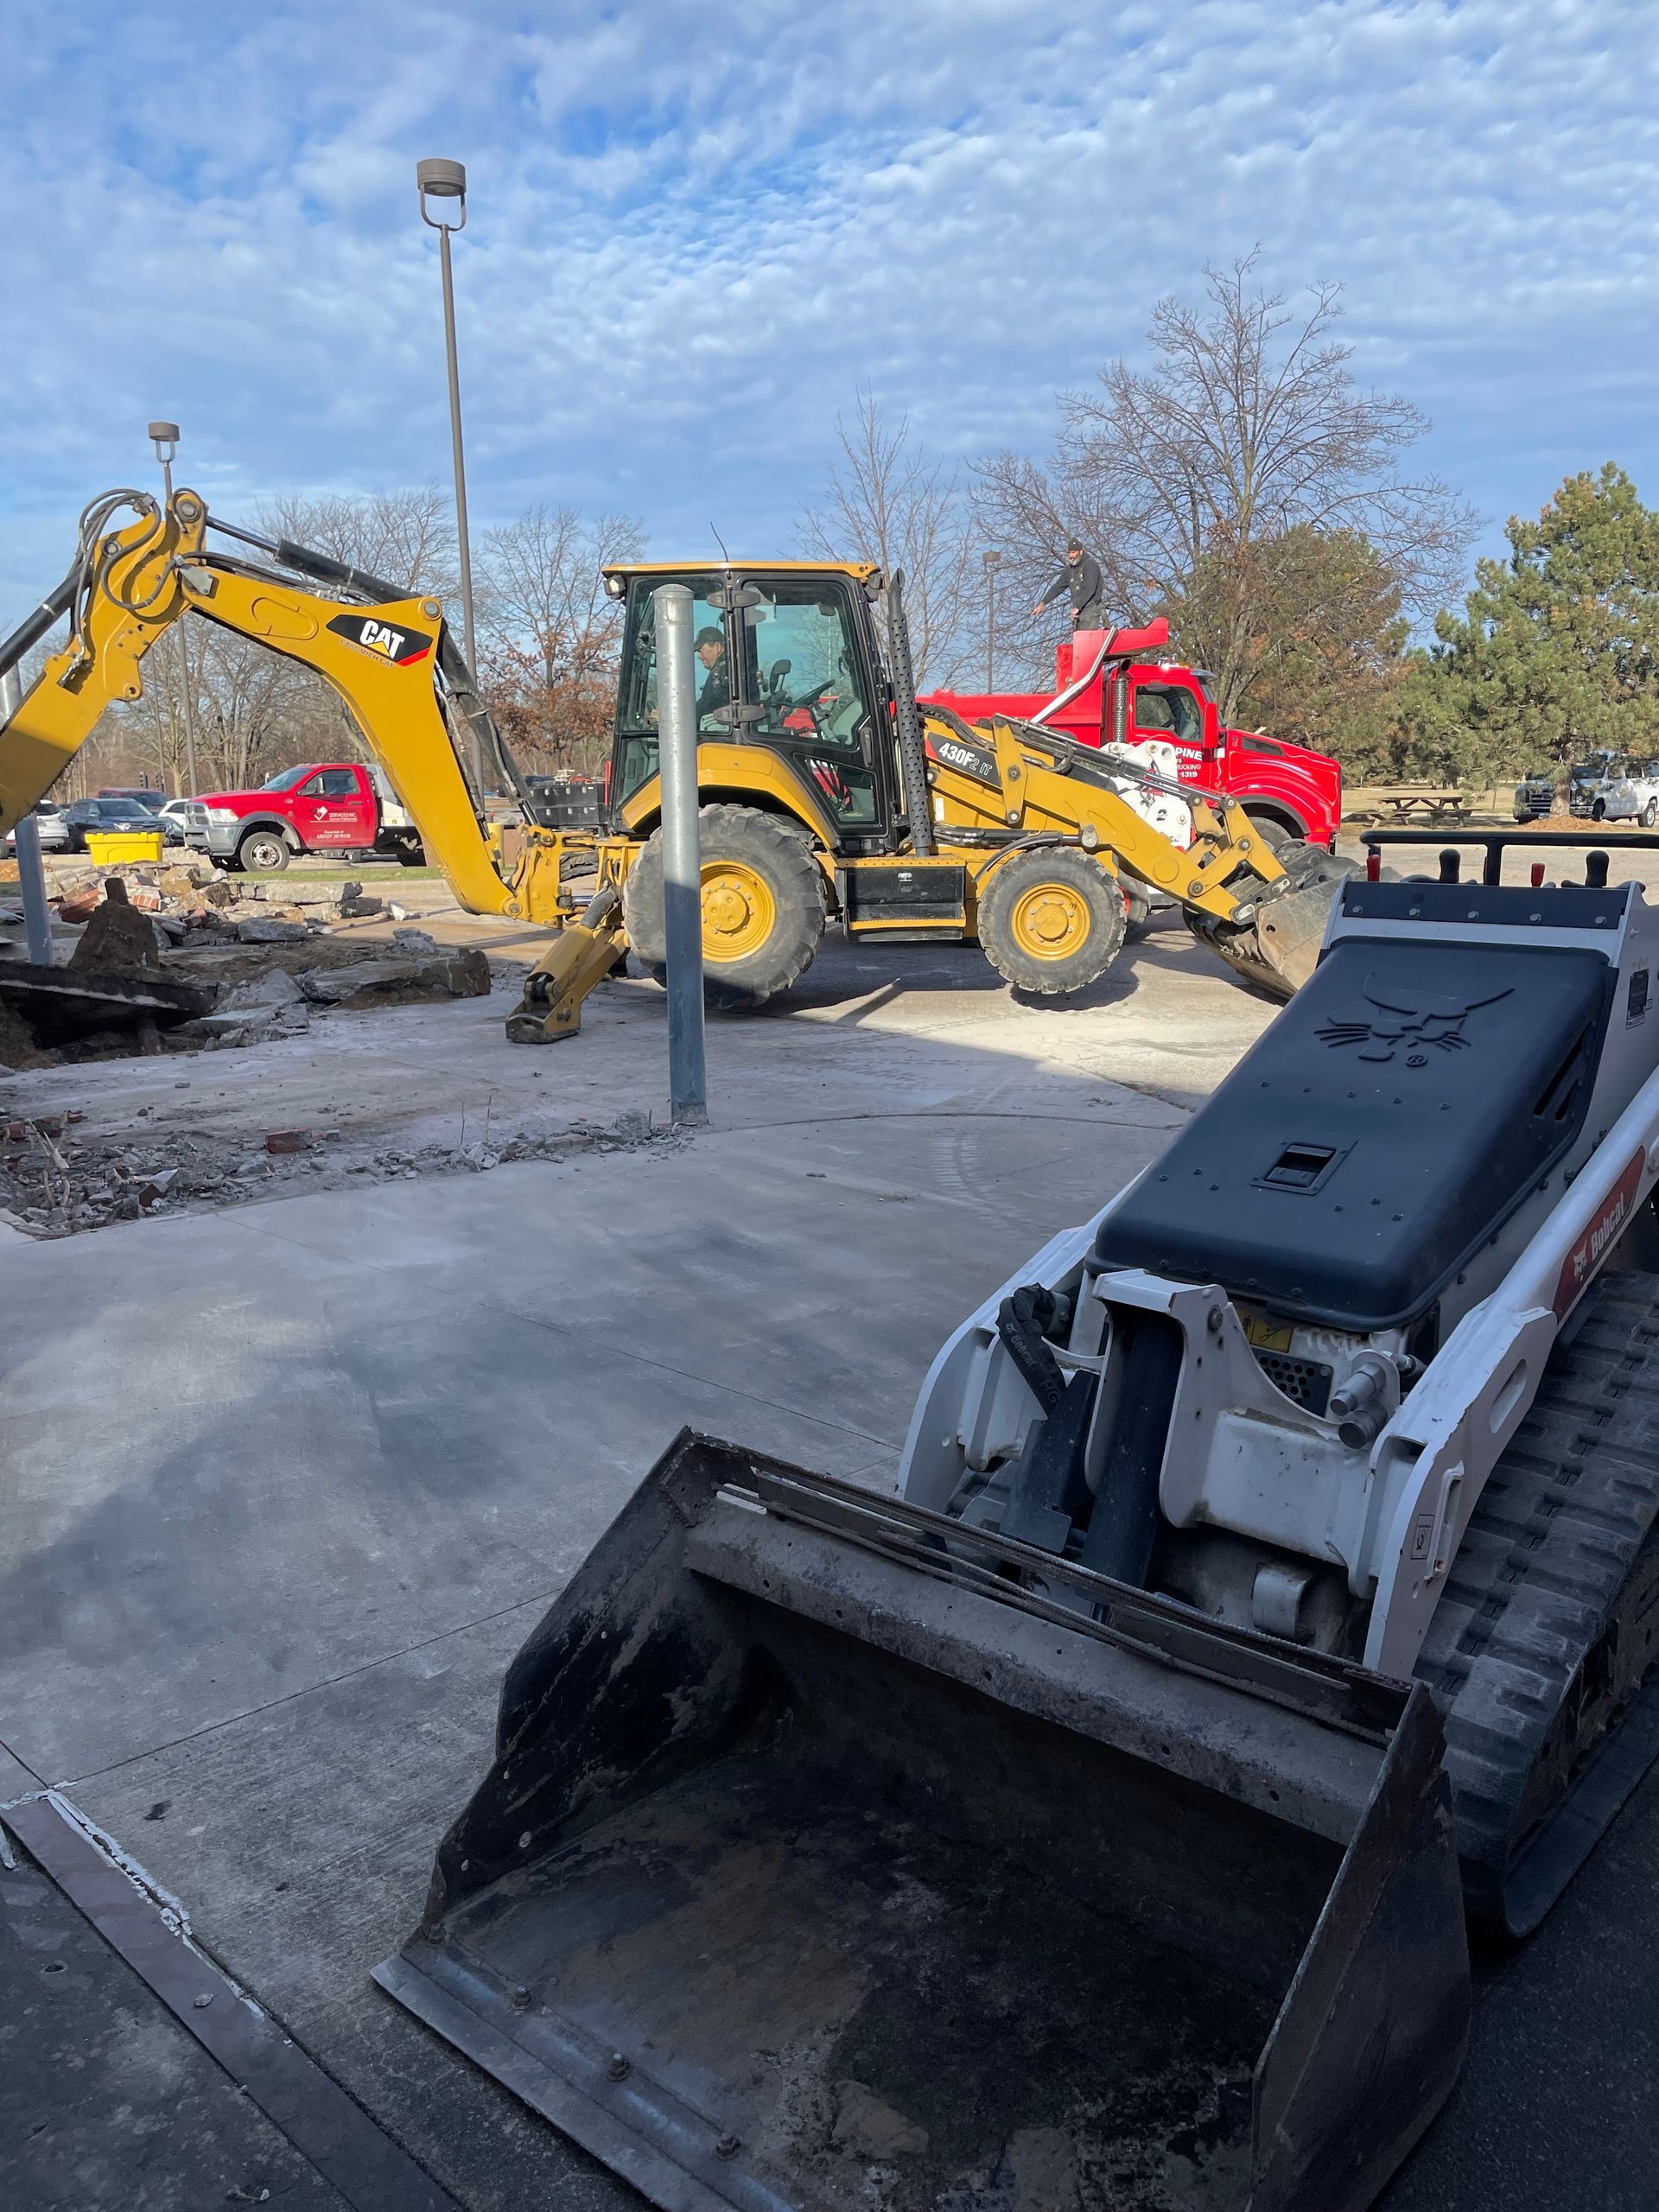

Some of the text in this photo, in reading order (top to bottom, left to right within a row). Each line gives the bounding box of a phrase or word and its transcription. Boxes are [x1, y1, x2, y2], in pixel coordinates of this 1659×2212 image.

[359, 620, 405, 658] CAT
[1175, 747, 1203, 761] PINE
[1591, 1191, 1625, 1262] Bobcat
